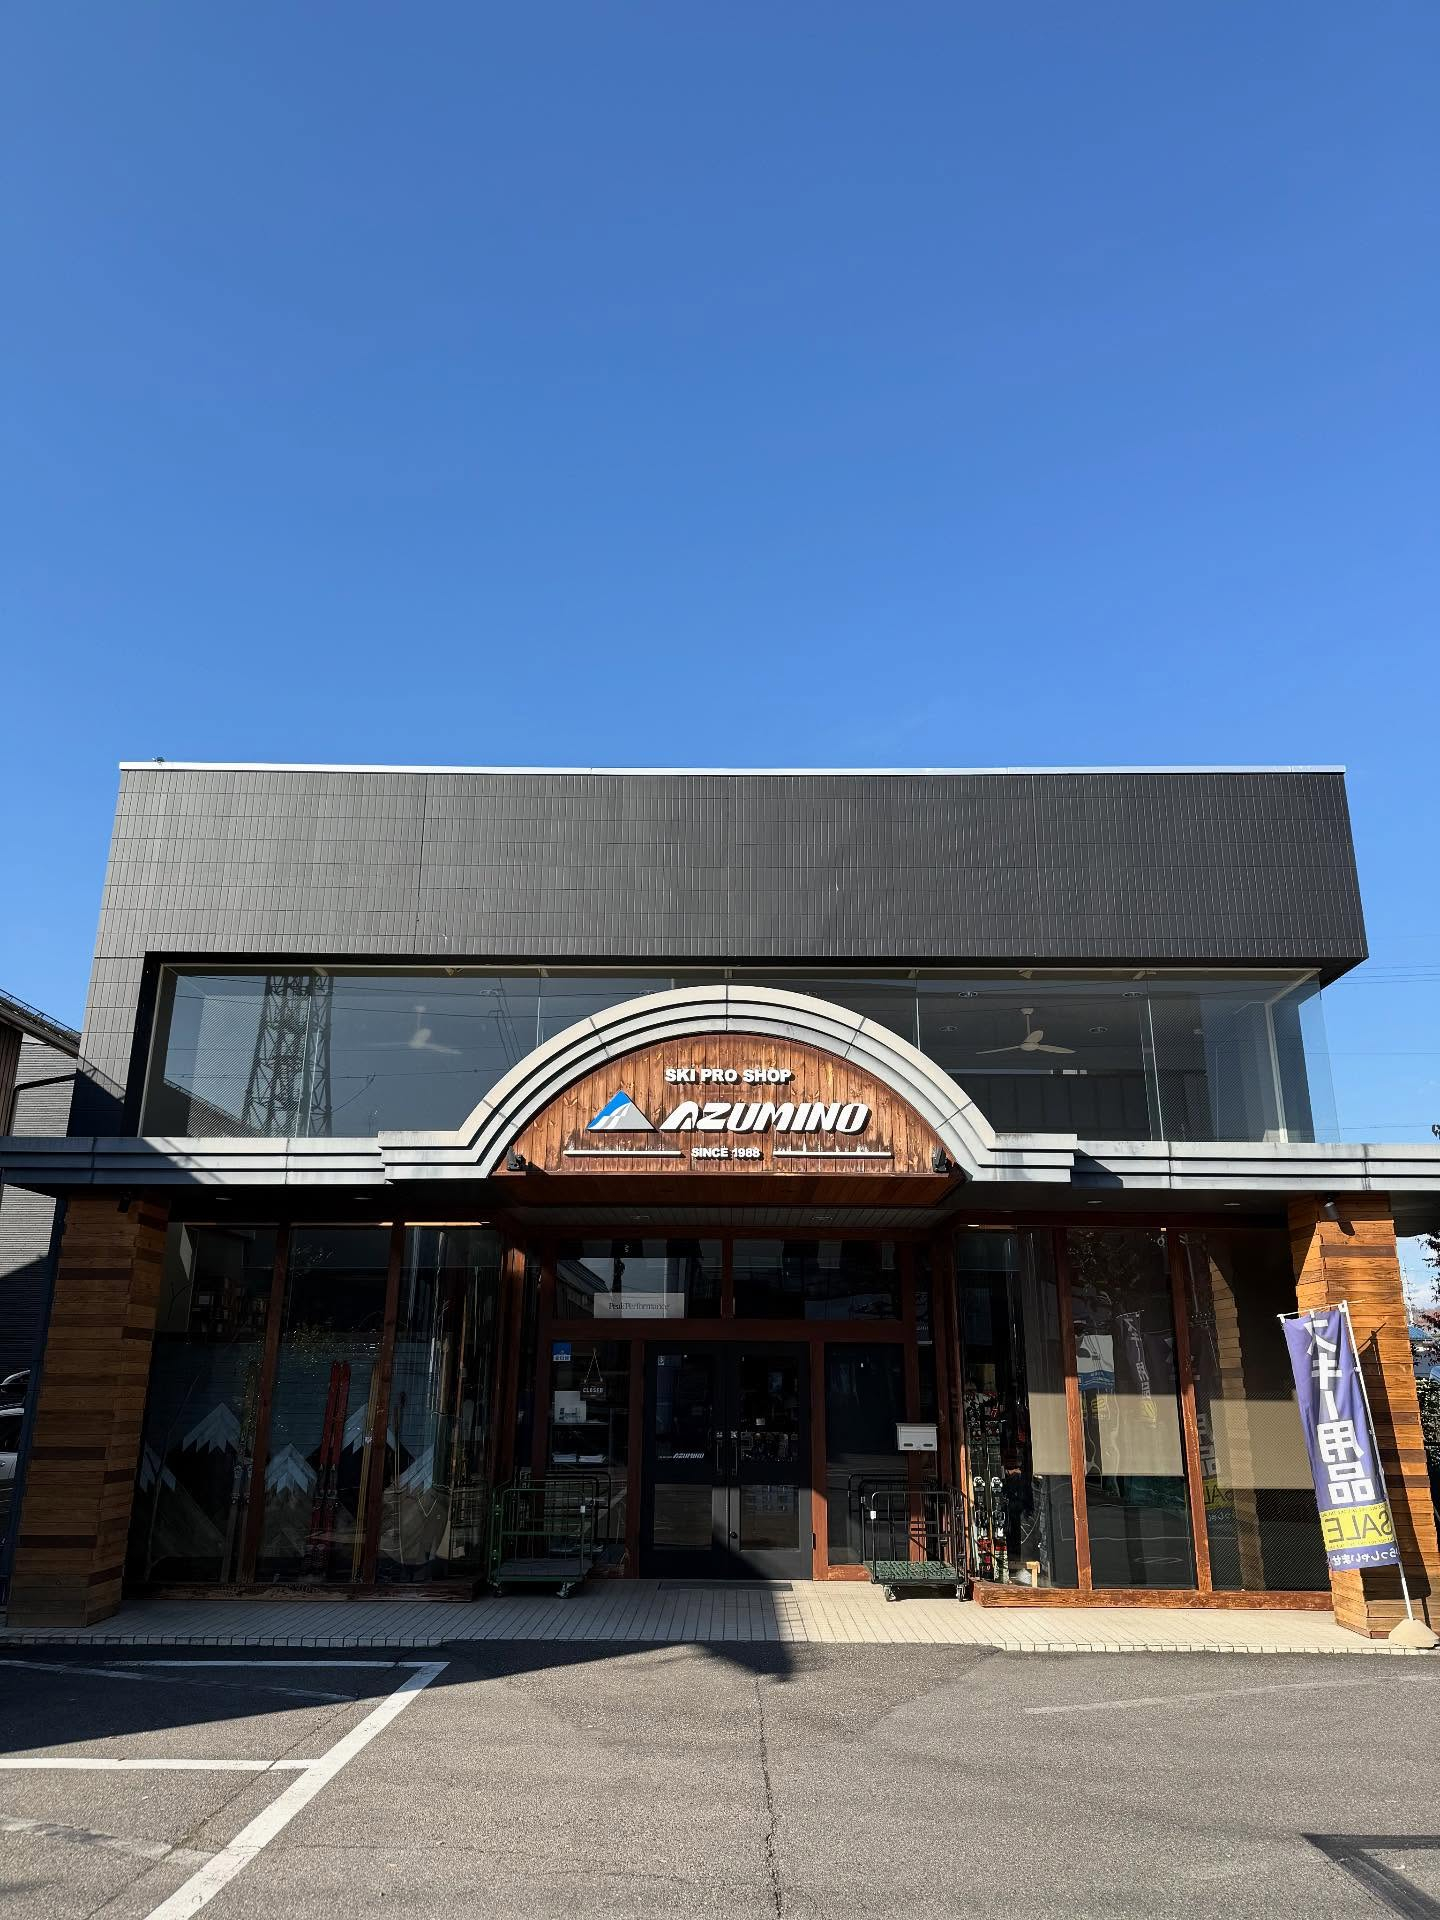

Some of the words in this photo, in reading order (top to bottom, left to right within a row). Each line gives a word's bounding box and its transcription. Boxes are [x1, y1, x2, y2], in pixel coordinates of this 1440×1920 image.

[664, 1068, 695, 1083] SKI
[700, 1068, 738, 1083] PRO
[742, 1068, 792, 1083] SHOP
[659, 1100, 871, 1134] AZUMINO
[690, 1147, 729, 1158] SINCE
[731, 1147, 760, 1158] 1988
